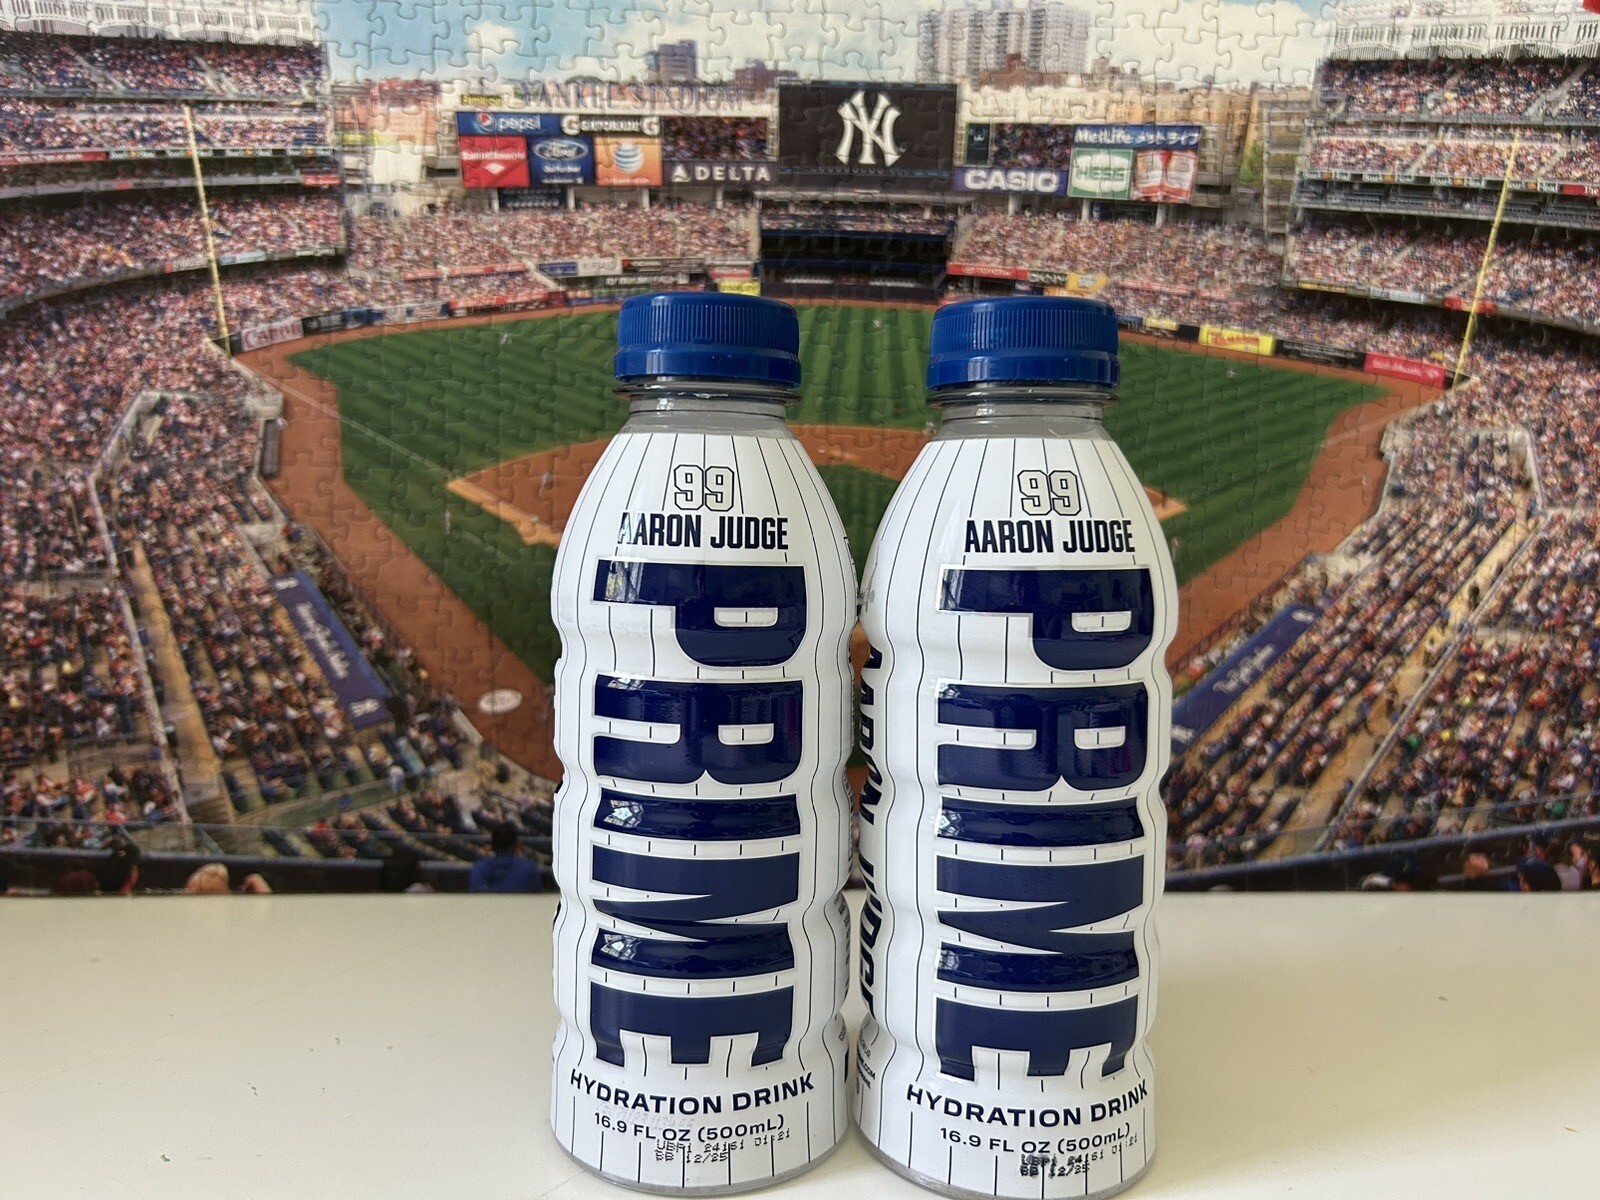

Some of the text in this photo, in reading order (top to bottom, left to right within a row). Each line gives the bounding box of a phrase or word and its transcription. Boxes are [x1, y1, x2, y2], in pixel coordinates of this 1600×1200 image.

[497, 114, 541, 131] pepsi
[1074, 126, 1132, 145] MetLife
[543, 141, 578, 157] Ford
[694, 164, 771, 182] DELTA
[964, 170, 1060, 193] CASIO
[1076, 166, 1125, 181] HESS
[673, 464, 735, 512] 99
[1017, 469, 1082, 516] 99
[617, 511, 789, 550] AARON JUDGE
[965, 519, 1136, 553] AARON JUDGE
[590, 559, 807, 1067] PRIME
[936, 568, 1154, 1081] PRIME
[570, 1068, 722, 1115] HYDRATION
[732, 1072, 815, 1112] DRINK
[906, 1079, 1149, 1128] HYDRATION DRINK
[594, 1112, 785, 1143] 16.9 FL OZ (500mL)
[940, 1122, 1130, 1154] 16.9 FL OZ (500mL)
